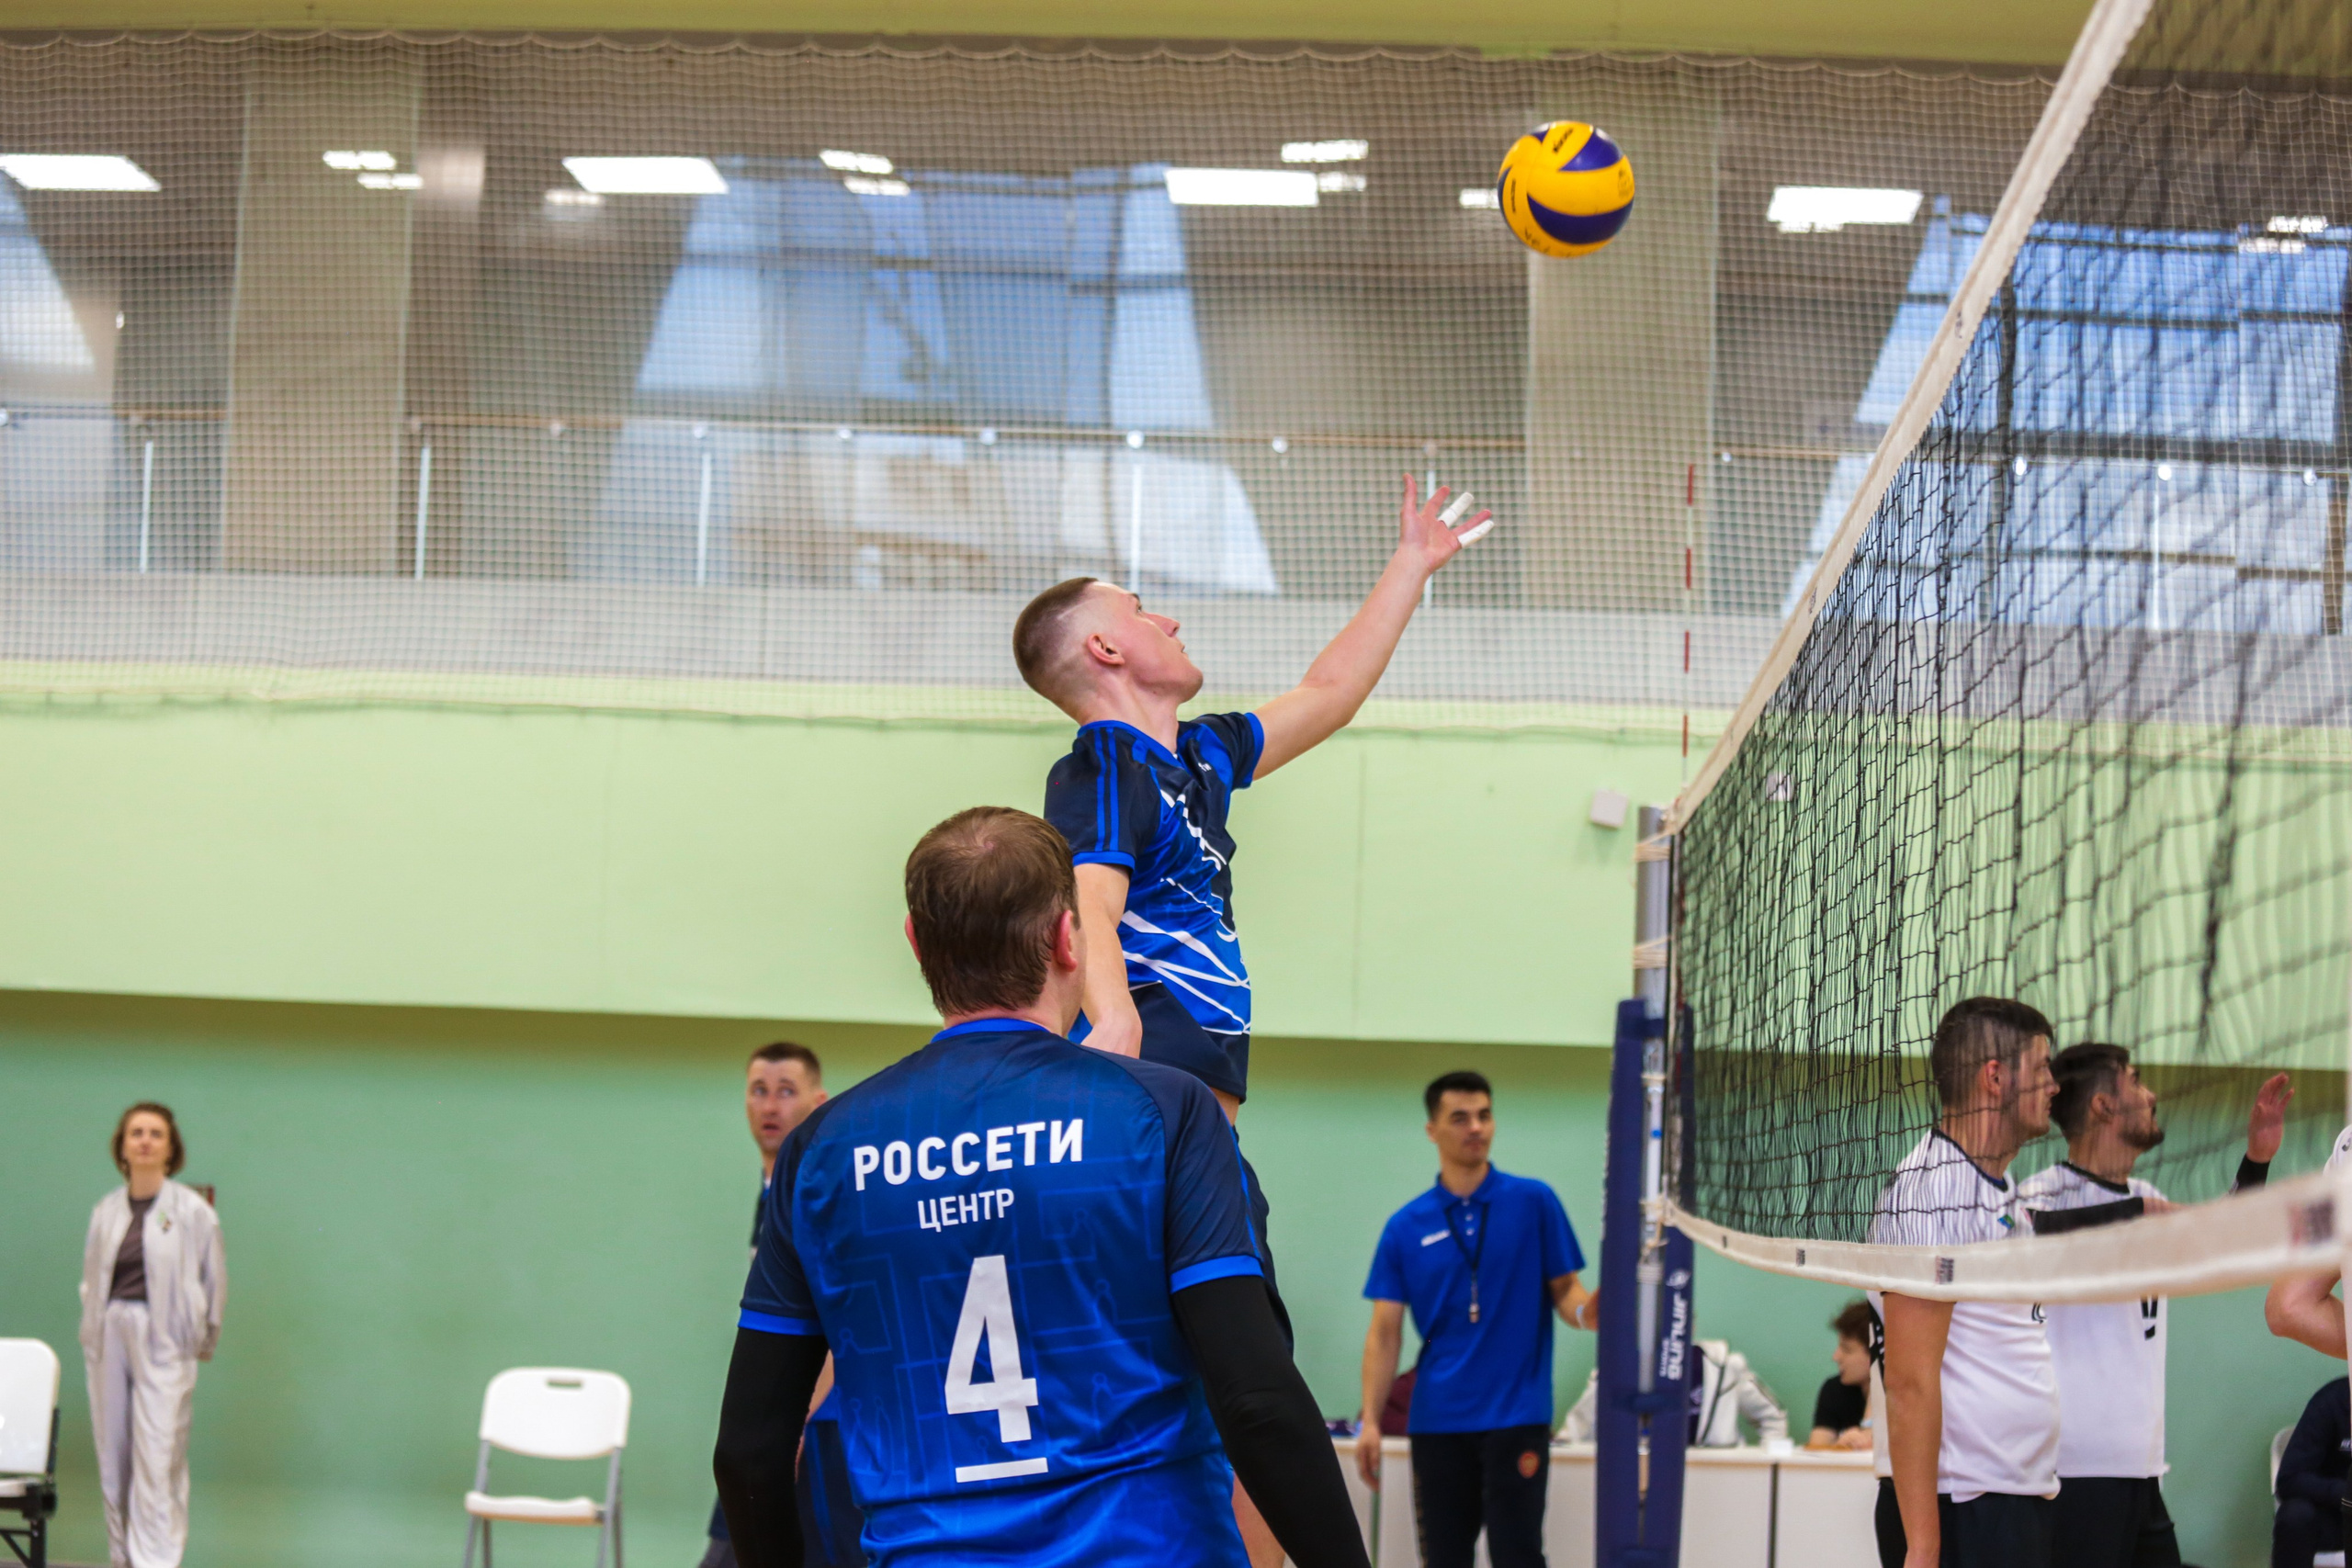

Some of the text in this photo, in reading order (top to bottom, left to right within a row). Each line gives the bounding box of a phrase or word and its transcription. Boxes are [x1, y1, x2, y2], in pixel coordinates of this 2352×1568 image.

[854, 1118, 1084, 1191] РОССЕТИ
[917, 1188, 1015, 1233] ЦЕНТР
[944, 1254, 1039, 1443] 4
